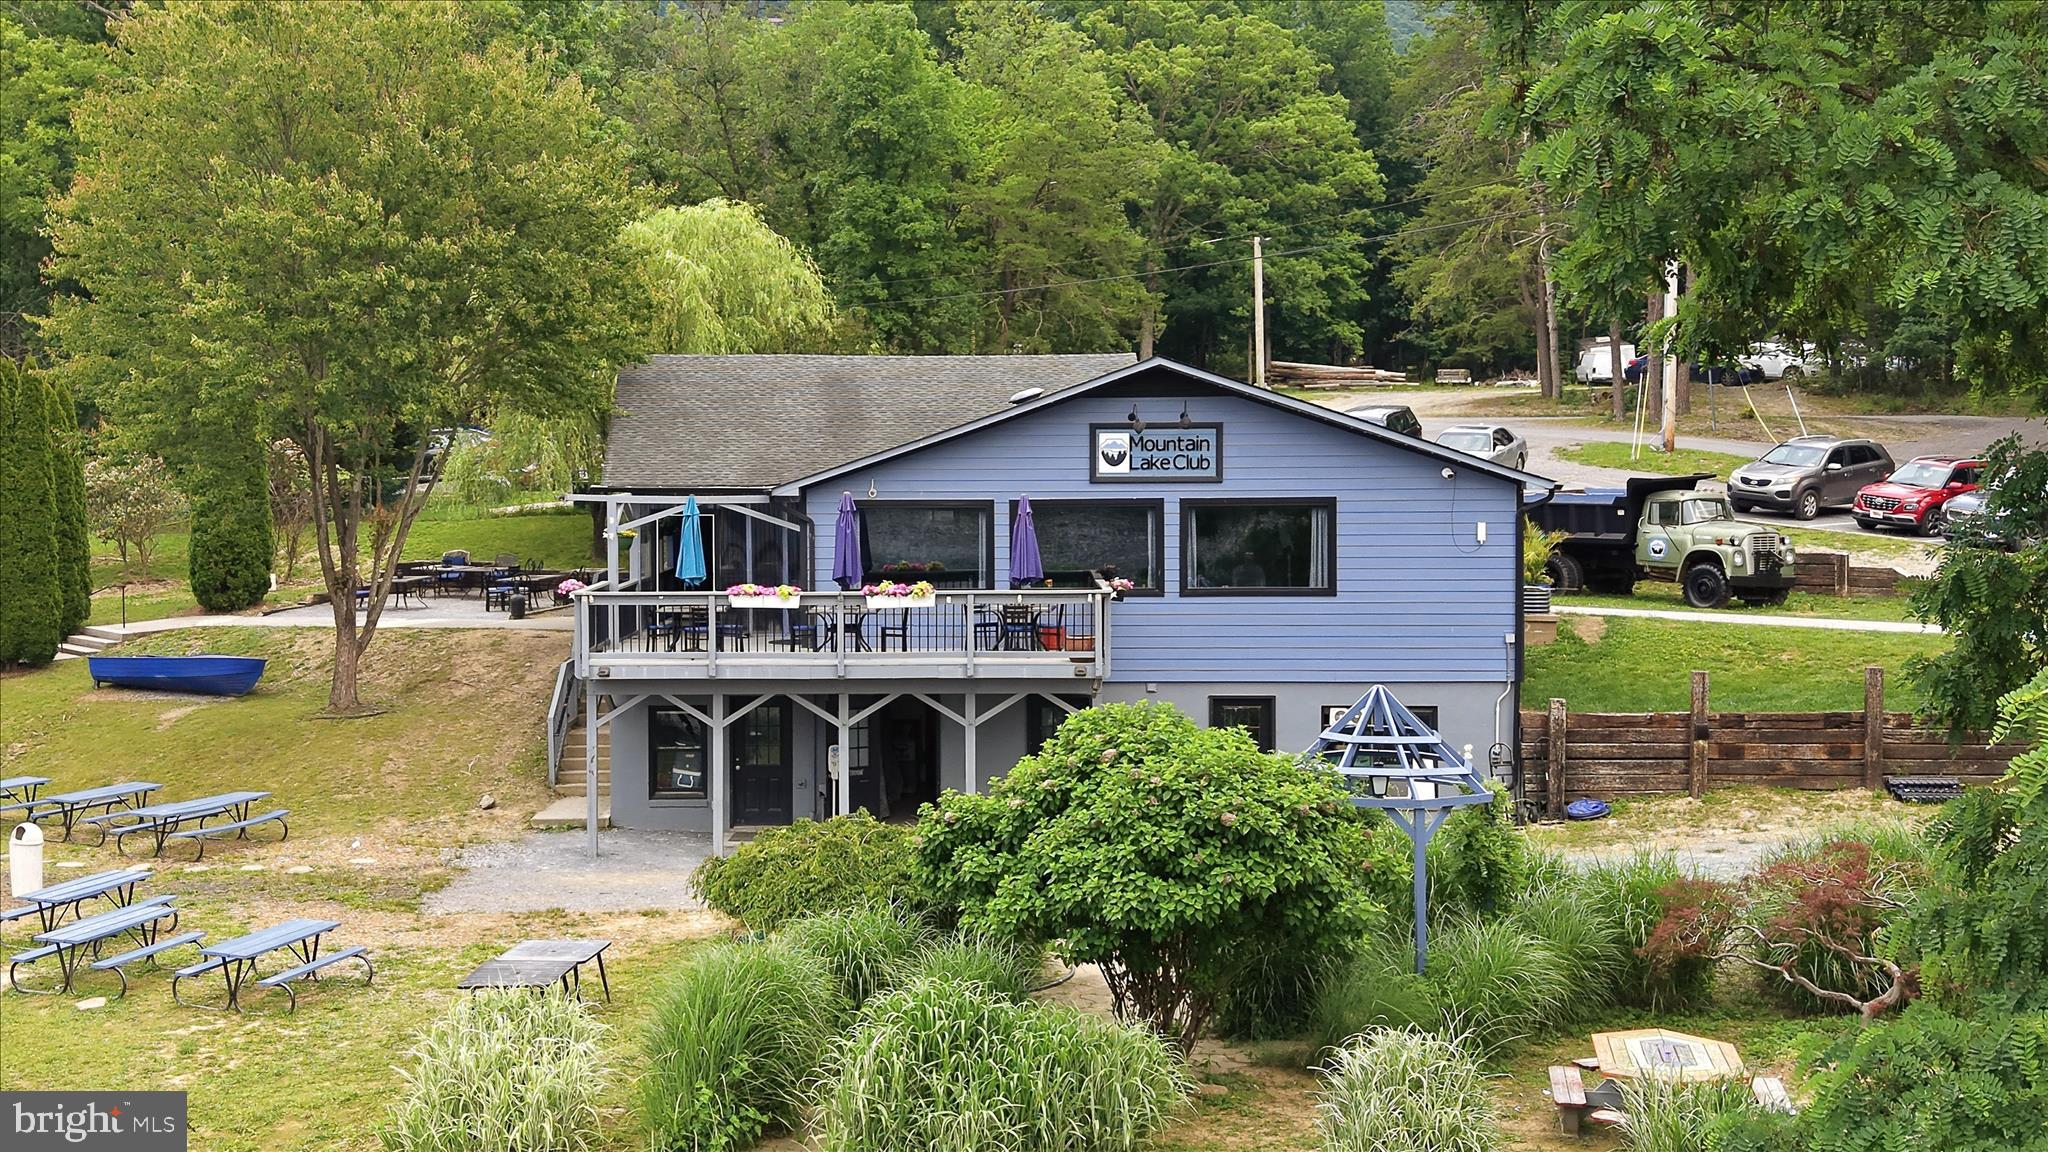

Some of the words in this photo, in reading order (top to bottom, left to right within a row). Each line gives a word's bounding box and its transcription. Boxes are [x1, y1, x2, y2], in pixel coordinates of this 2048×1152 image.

[1129, 435, 1210, 452] Mountain
[1129, 454, 1171, 470] Lake
[1173, 454, 1211, 470] Club
